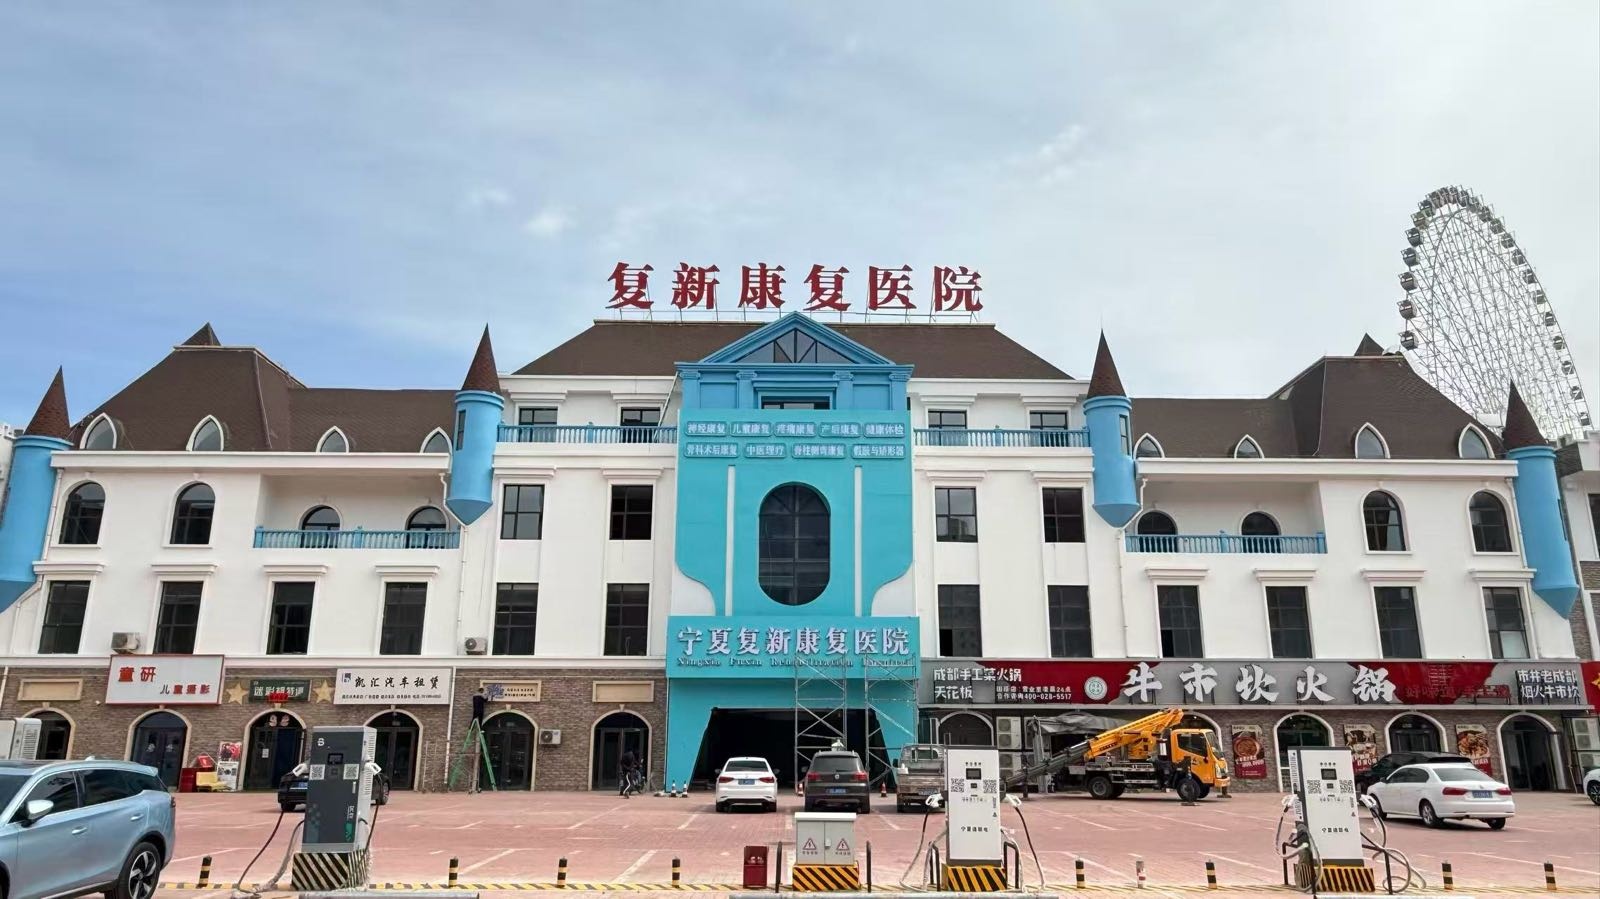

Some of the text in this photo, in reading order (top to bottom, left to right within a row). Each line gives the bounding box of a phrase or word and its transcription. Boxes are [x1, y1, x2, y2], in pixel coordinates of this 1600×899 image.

[607, 262, 984, 312] 复新康复医院
[687, 422, 726, 435] 神经康复
[732, 423, 770, 435] 儿童康复
[776, 424, 815, 436] 疼痛康复
[821, 424, 860, 436] 产后康复
[865, 424, 905, 436] 健康体检
[686, 444, 738, 456] 骨科术后康复
[746, 444, 785, 457] 中医理疗
[793, 445, 845, 457] 脊柱侧弯康复
[852, 445, 905, 457] 假肢与矫形器
[677, 627, 910, 655] 宁夏复新康复医院
[118, 666, 156, 682] 童研
[933, 667, 1022, 682] 成都手工菜火锅
[1517, 669, 1577, 683] 市井老成都
[355, 675, 439, 689] 凯汇汽车租赁
[160, 684, 211, 695] 儿童摄影
[934, 686, 973, 700] 天花板
[1521, 685, 1582, 700] 烟火牛市坎
